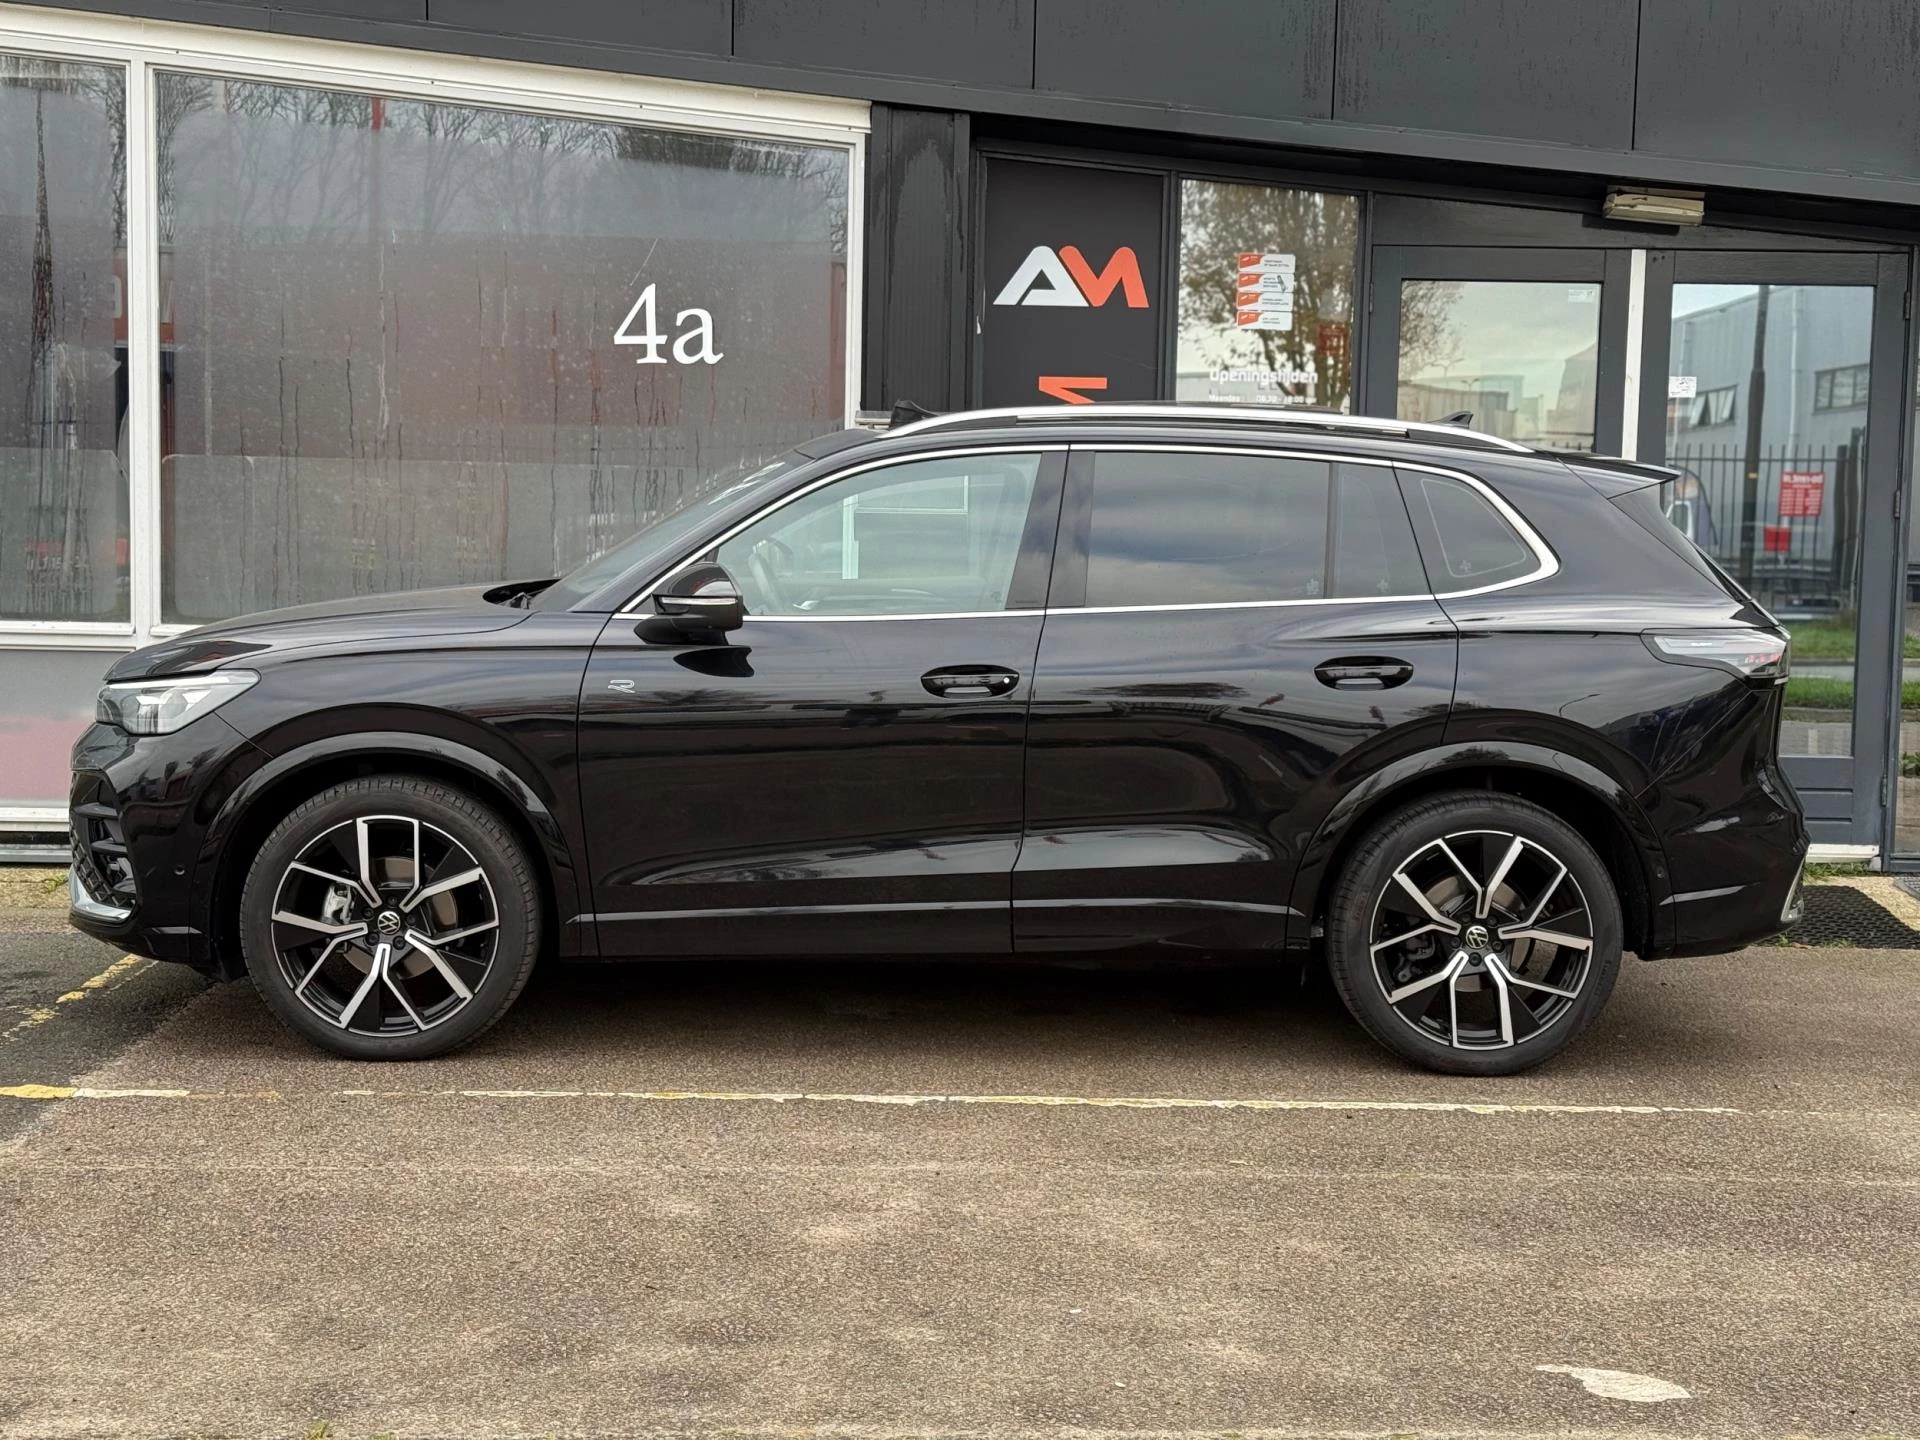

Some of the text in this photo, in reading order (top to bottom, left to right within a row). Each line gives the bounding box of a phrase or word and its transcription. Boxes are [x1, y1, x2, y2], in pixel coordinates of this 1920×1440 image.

[992, 245, 1149, 308] AM
[613, 283, 724, 364] 4a
[1210, 369, 1318, 385] Openingstijden
[608, 680, 636, 693] R
